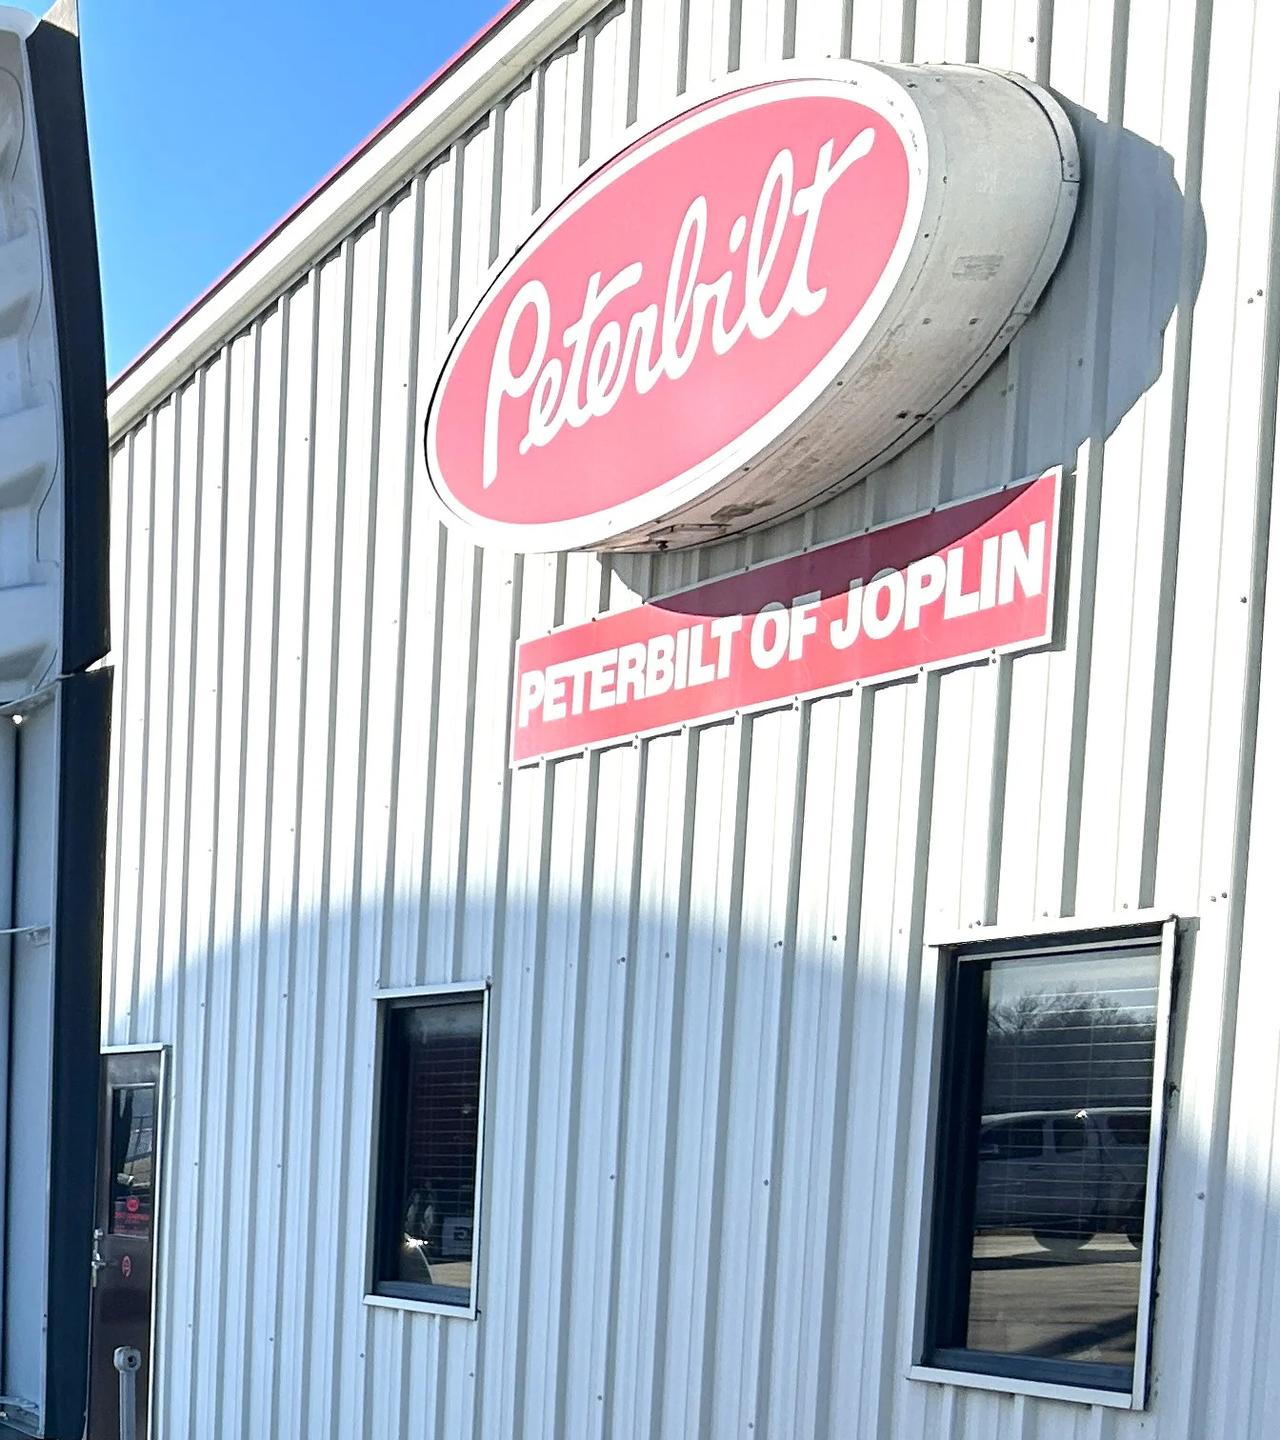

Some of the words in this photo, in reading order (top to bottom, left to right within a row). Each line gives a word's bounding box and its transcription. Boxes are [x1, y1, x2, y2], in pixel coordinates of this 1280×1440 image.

[483, 127, 876, 490] Peterbilt
[518, 613, 743, 728] PETERBILT
[750, 590, 822, 670] OF
[830, 520, 1046, 650] JOPLIN
